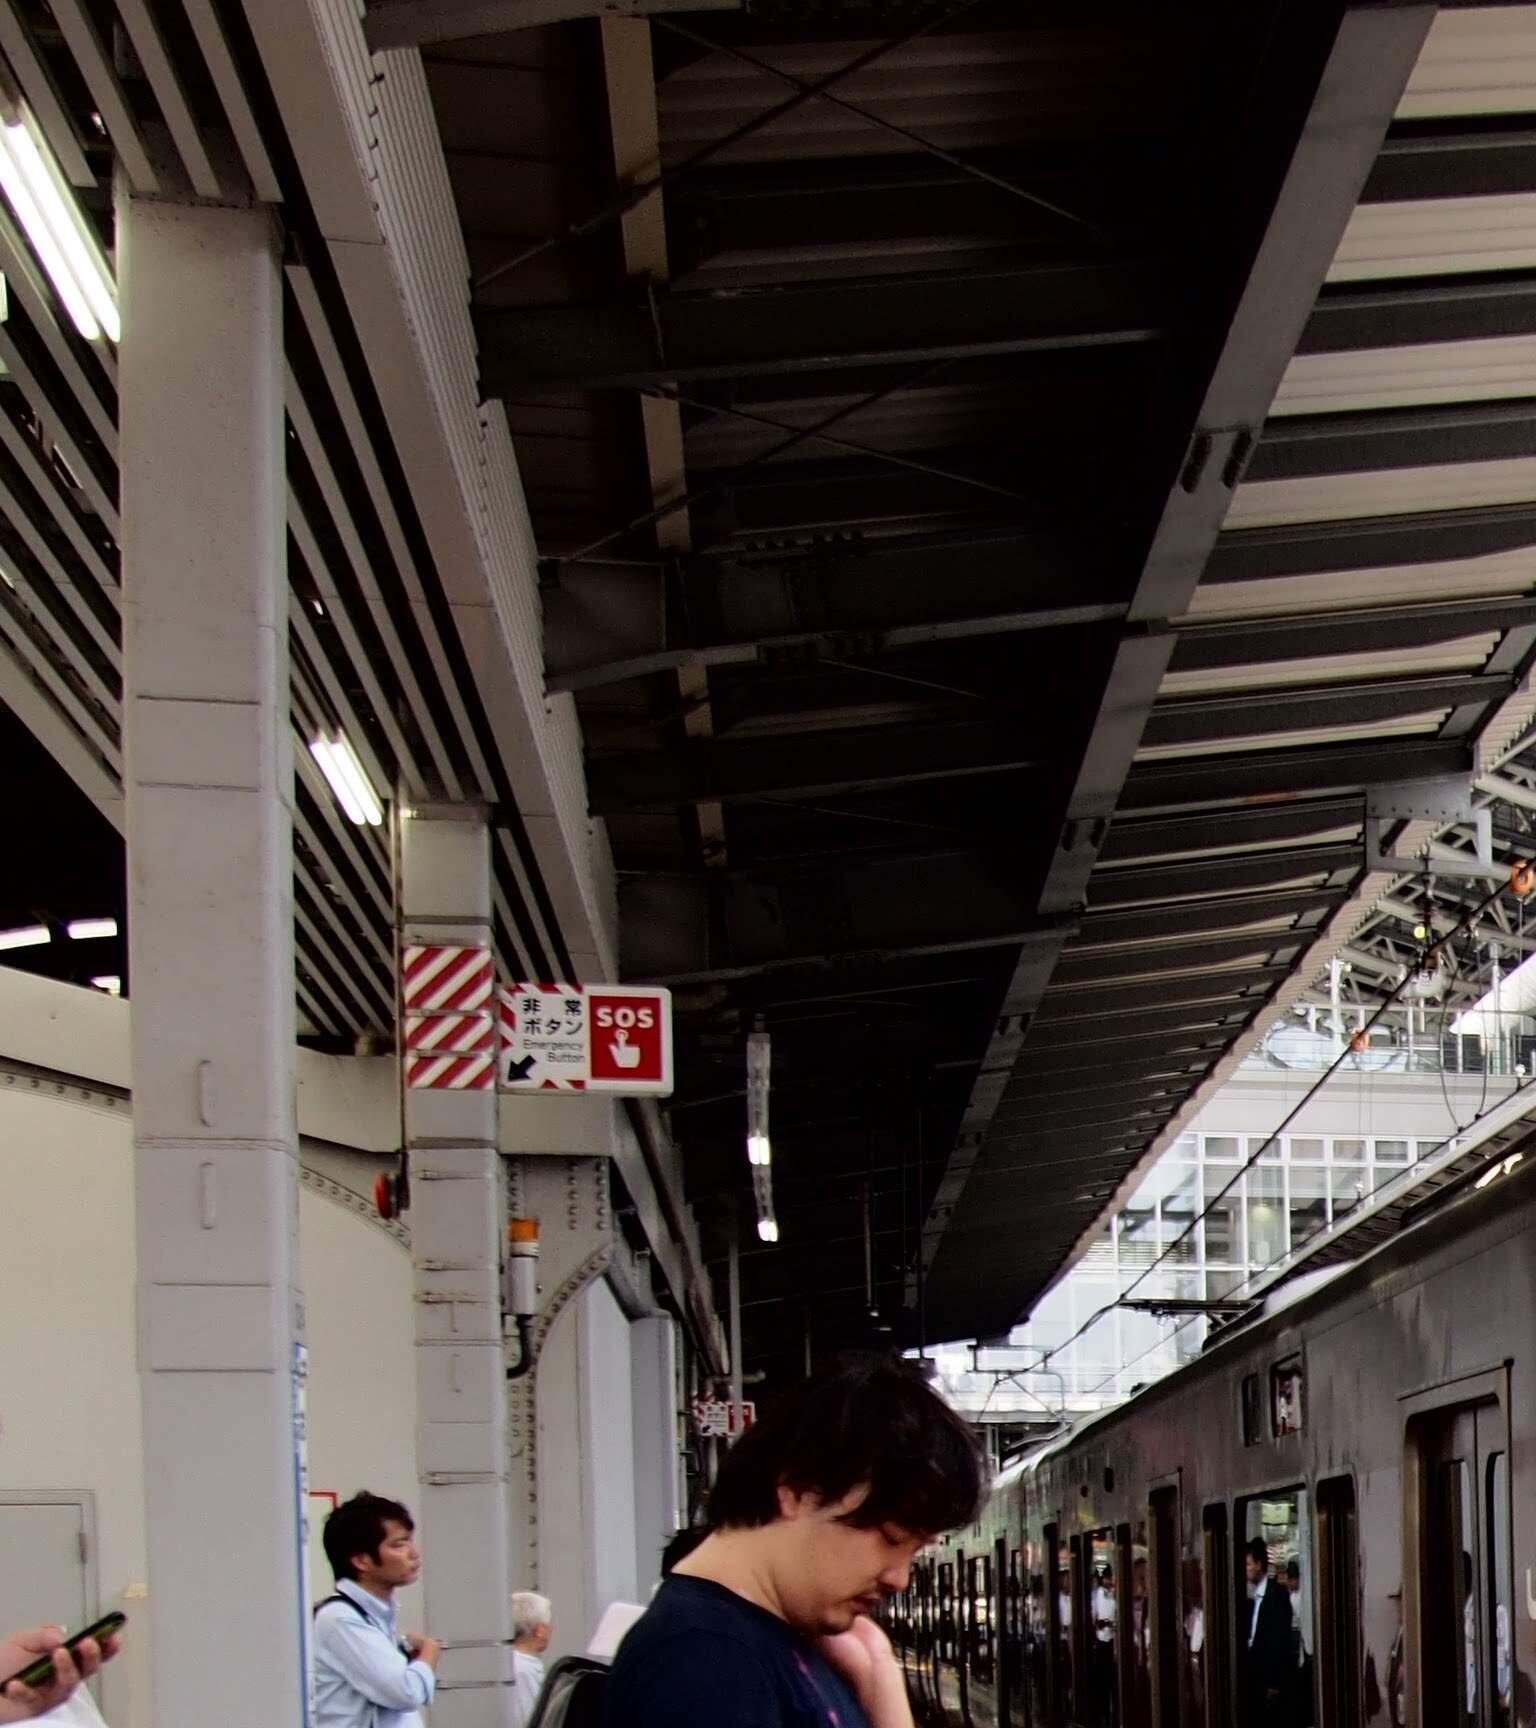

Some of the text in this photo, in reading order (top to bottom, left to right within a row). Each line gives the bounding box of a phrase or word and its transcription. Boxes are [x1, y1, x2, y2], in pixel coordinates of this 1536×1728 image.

[522, 998, 583, 1017] 非常
[596, 1005, 654, 1029] SOS
[522, 1018, 583, 1036] ボタン
[522, 1038, 584, 1051] Emergency
[547, 1051, 585, 1064] Button
